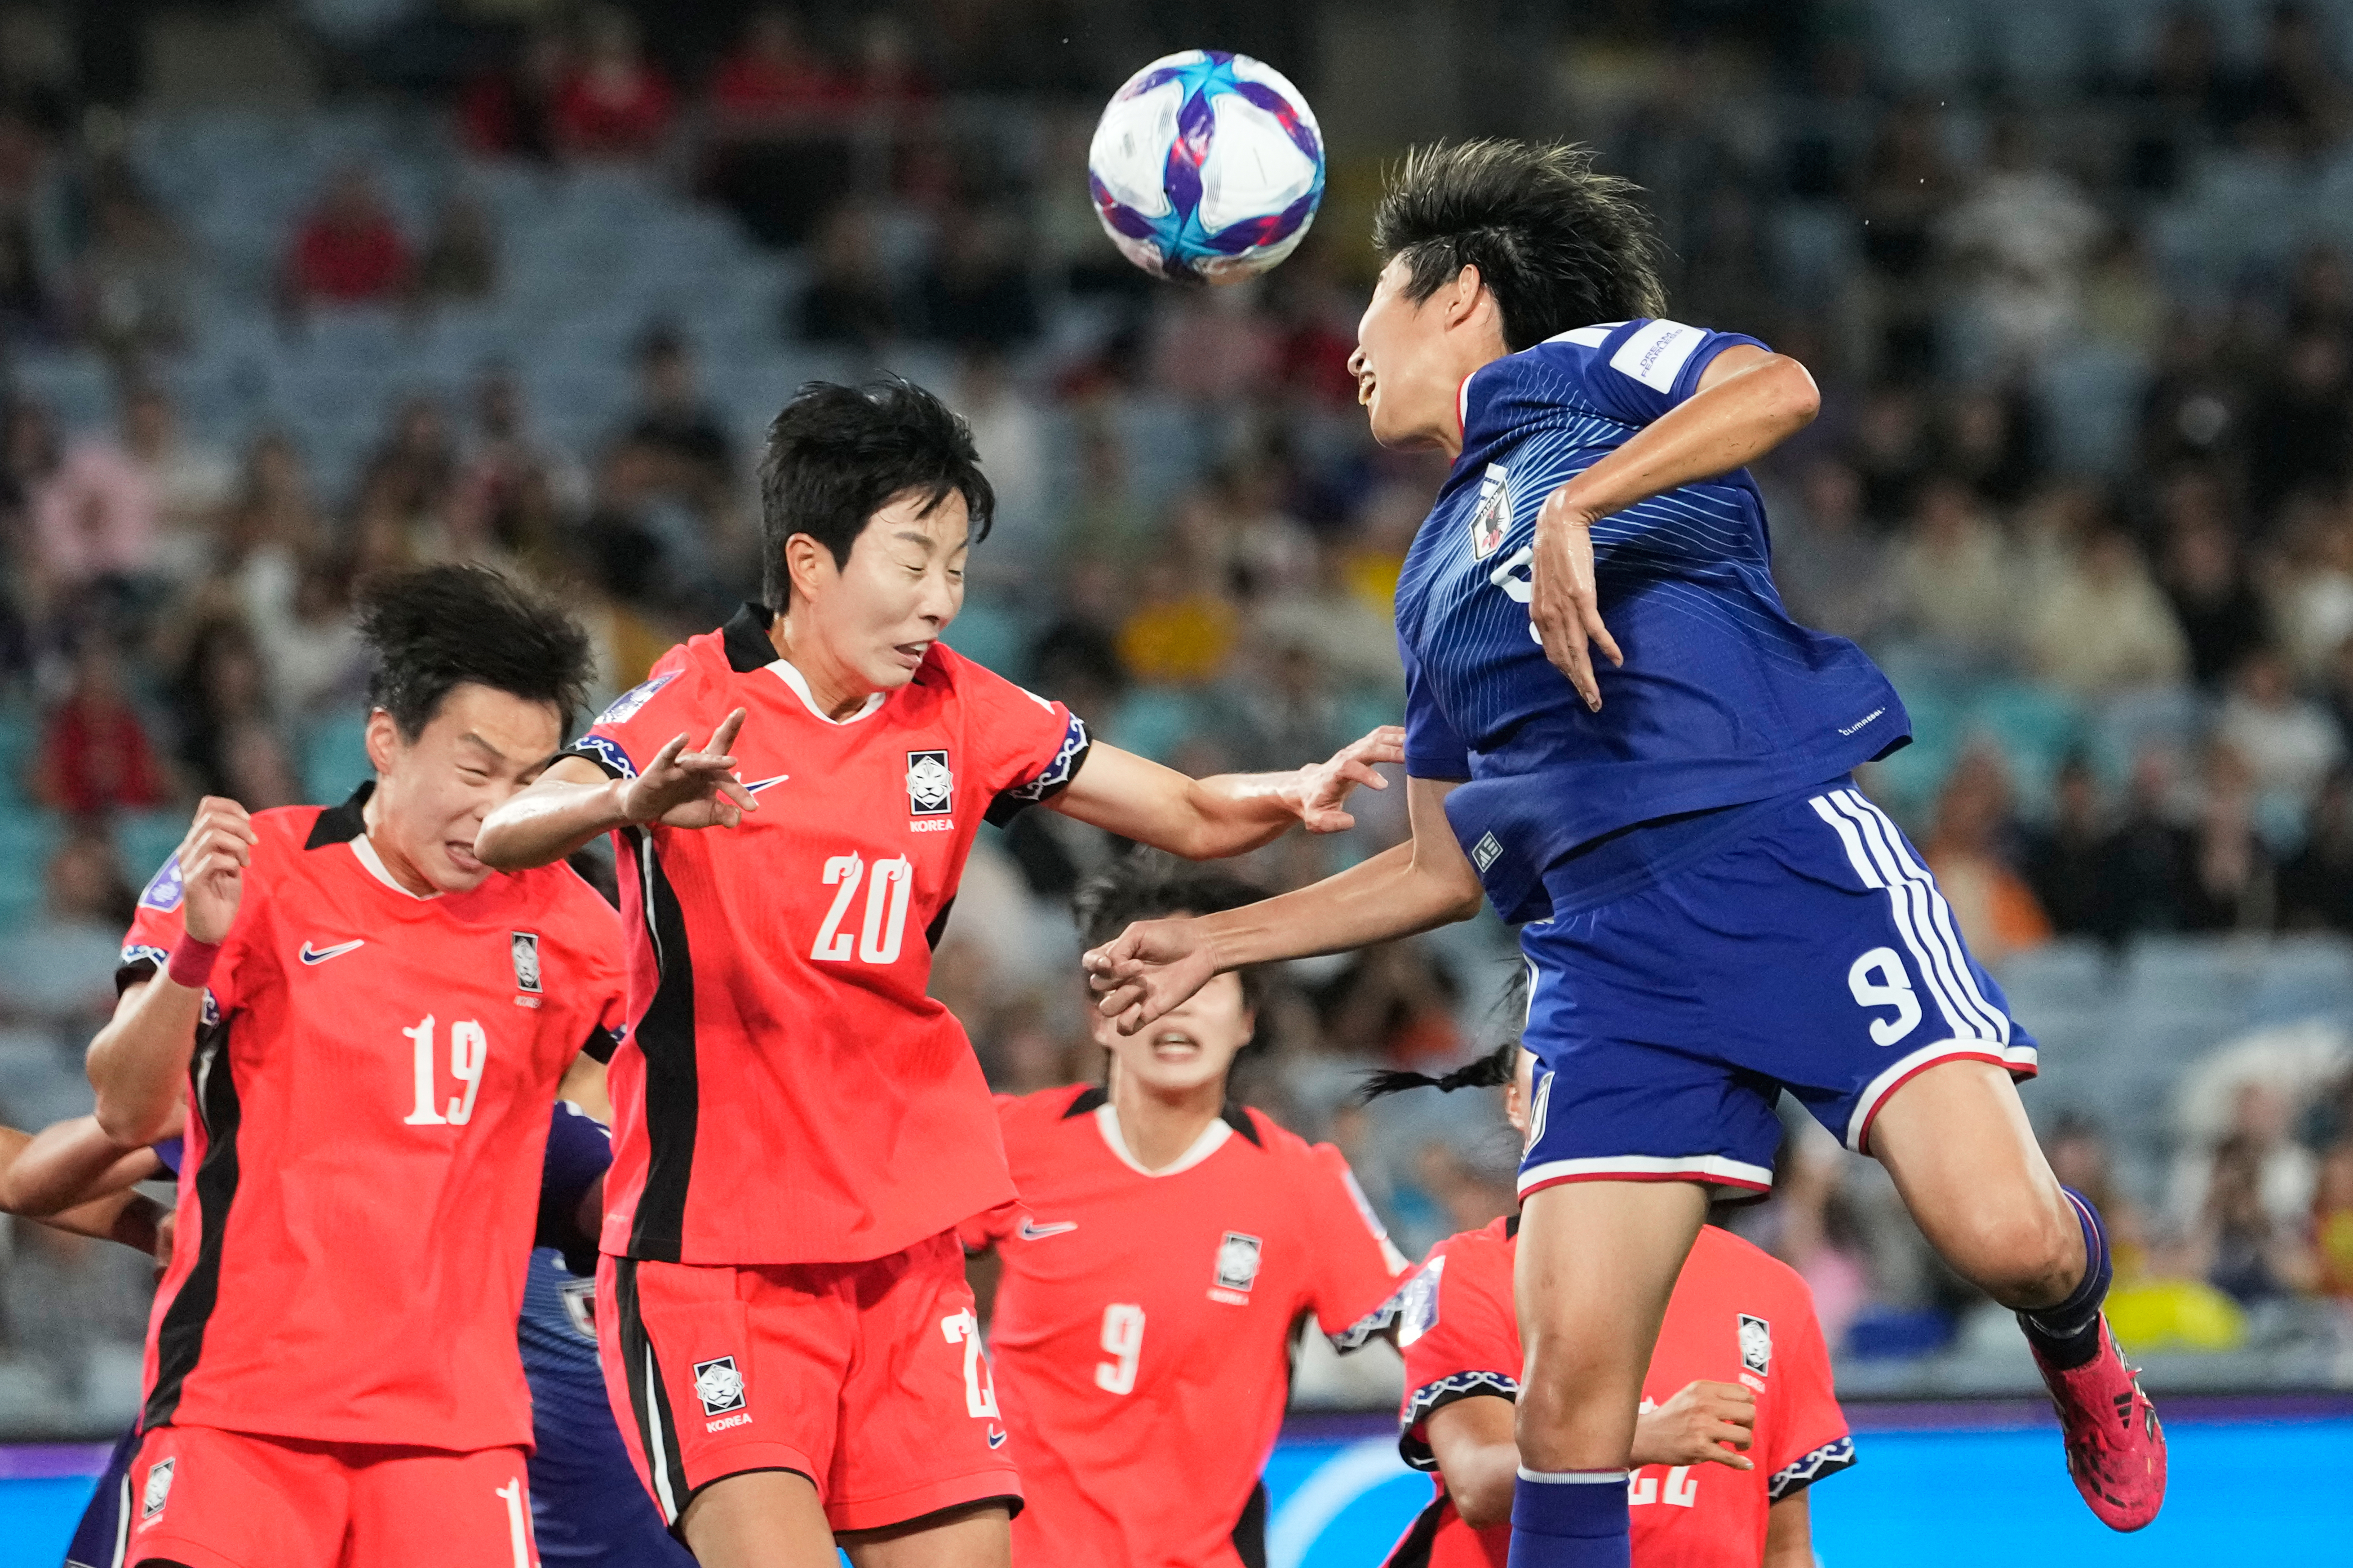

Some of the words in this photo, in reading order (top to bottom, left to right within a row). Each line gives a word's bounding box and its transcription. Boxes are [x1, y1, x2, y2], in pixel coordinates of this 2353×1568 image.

[1640, 332, 1672, 366] DREAM
[1641, 329, 1683, 377] FEARLESS
[910, 819, 954, 832] KOREA
[810, 850, 912, 963] 20
[1848, 947, 1922, 1046] 9
[402, 1013, 486, 1125] 19
[941, 1307, 1002, 1420] 2
[1095, 1303, 1145, 1396] 9
[706, 1413, 753, 1433] KOREA
[495, 1476, 542, 1568] 1
